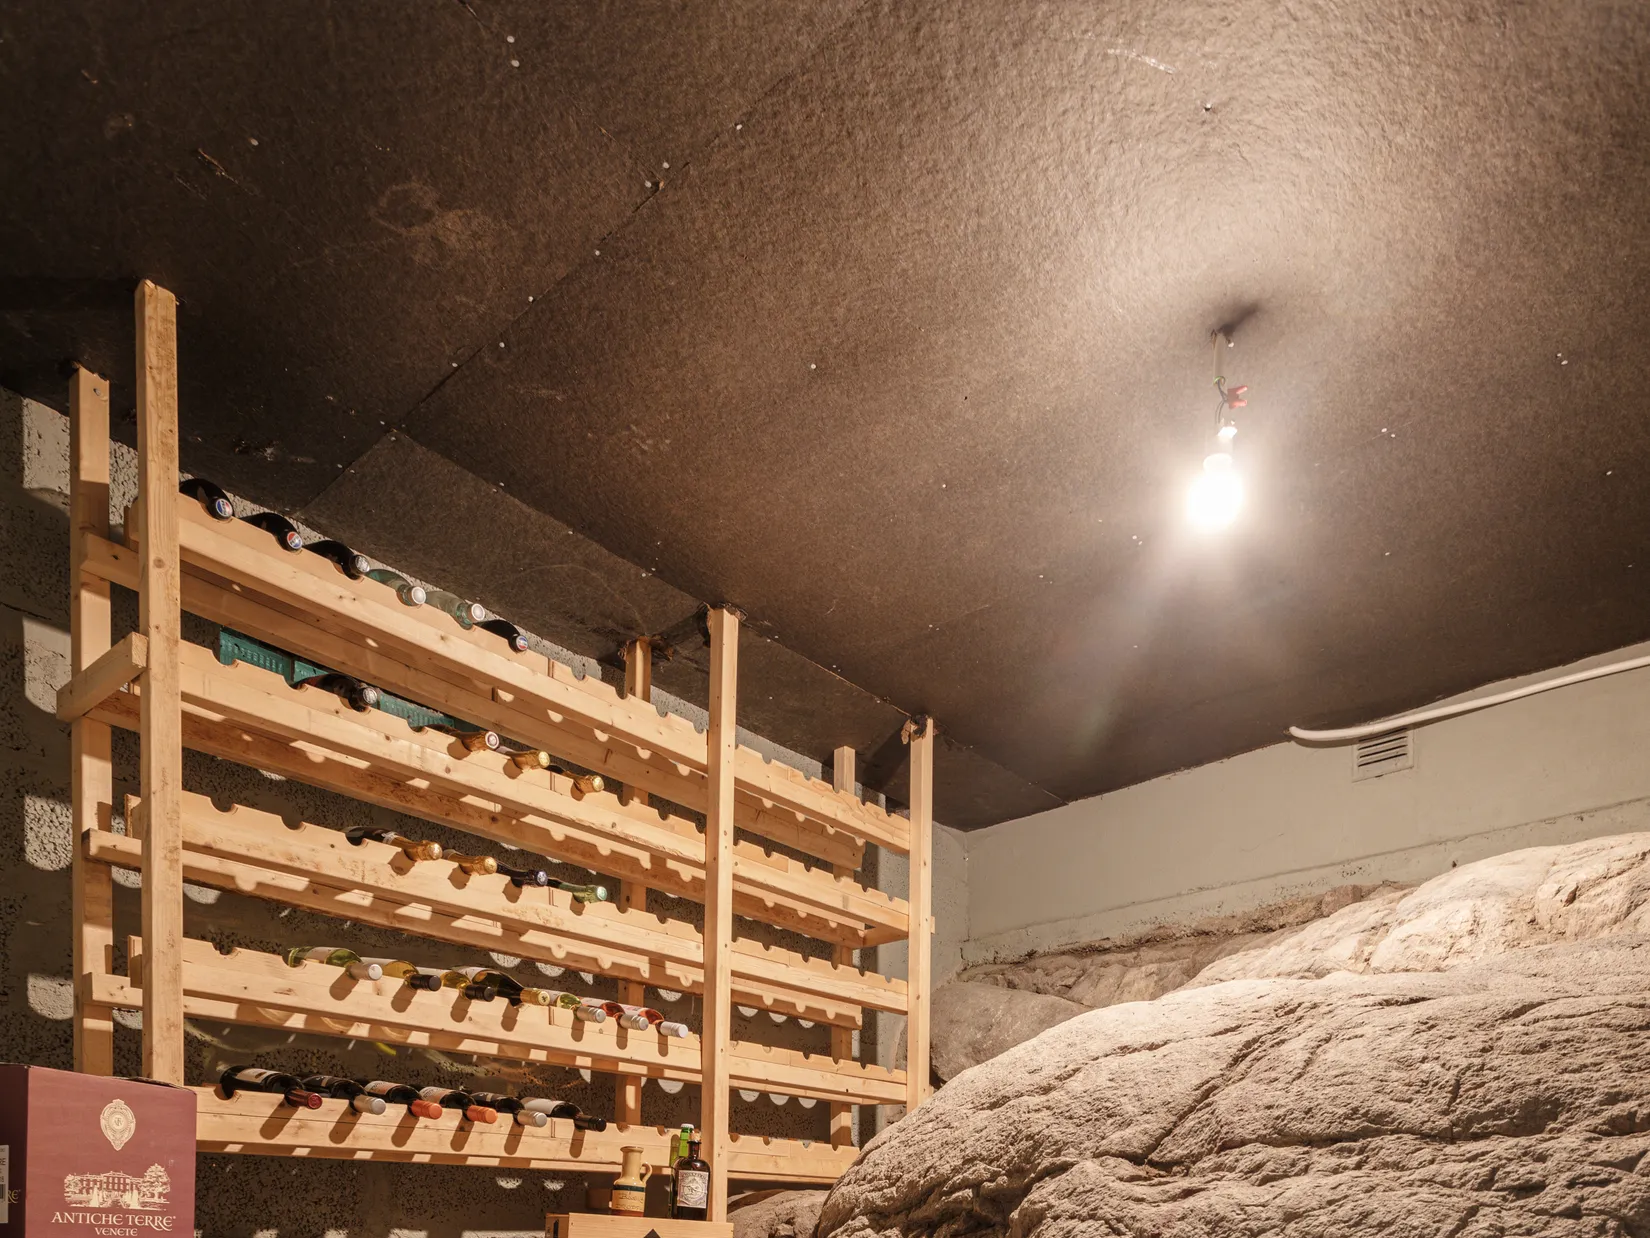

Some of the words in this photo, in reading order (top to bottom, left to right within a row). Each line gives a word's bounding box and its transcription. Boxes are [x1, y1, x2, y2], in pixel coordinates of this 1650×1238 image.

[51, 1211, 123, 1226] ANTICHE
[125, 1214, 173, 1232] TERRE
[95, 1227, 138, 1237] VENETE
